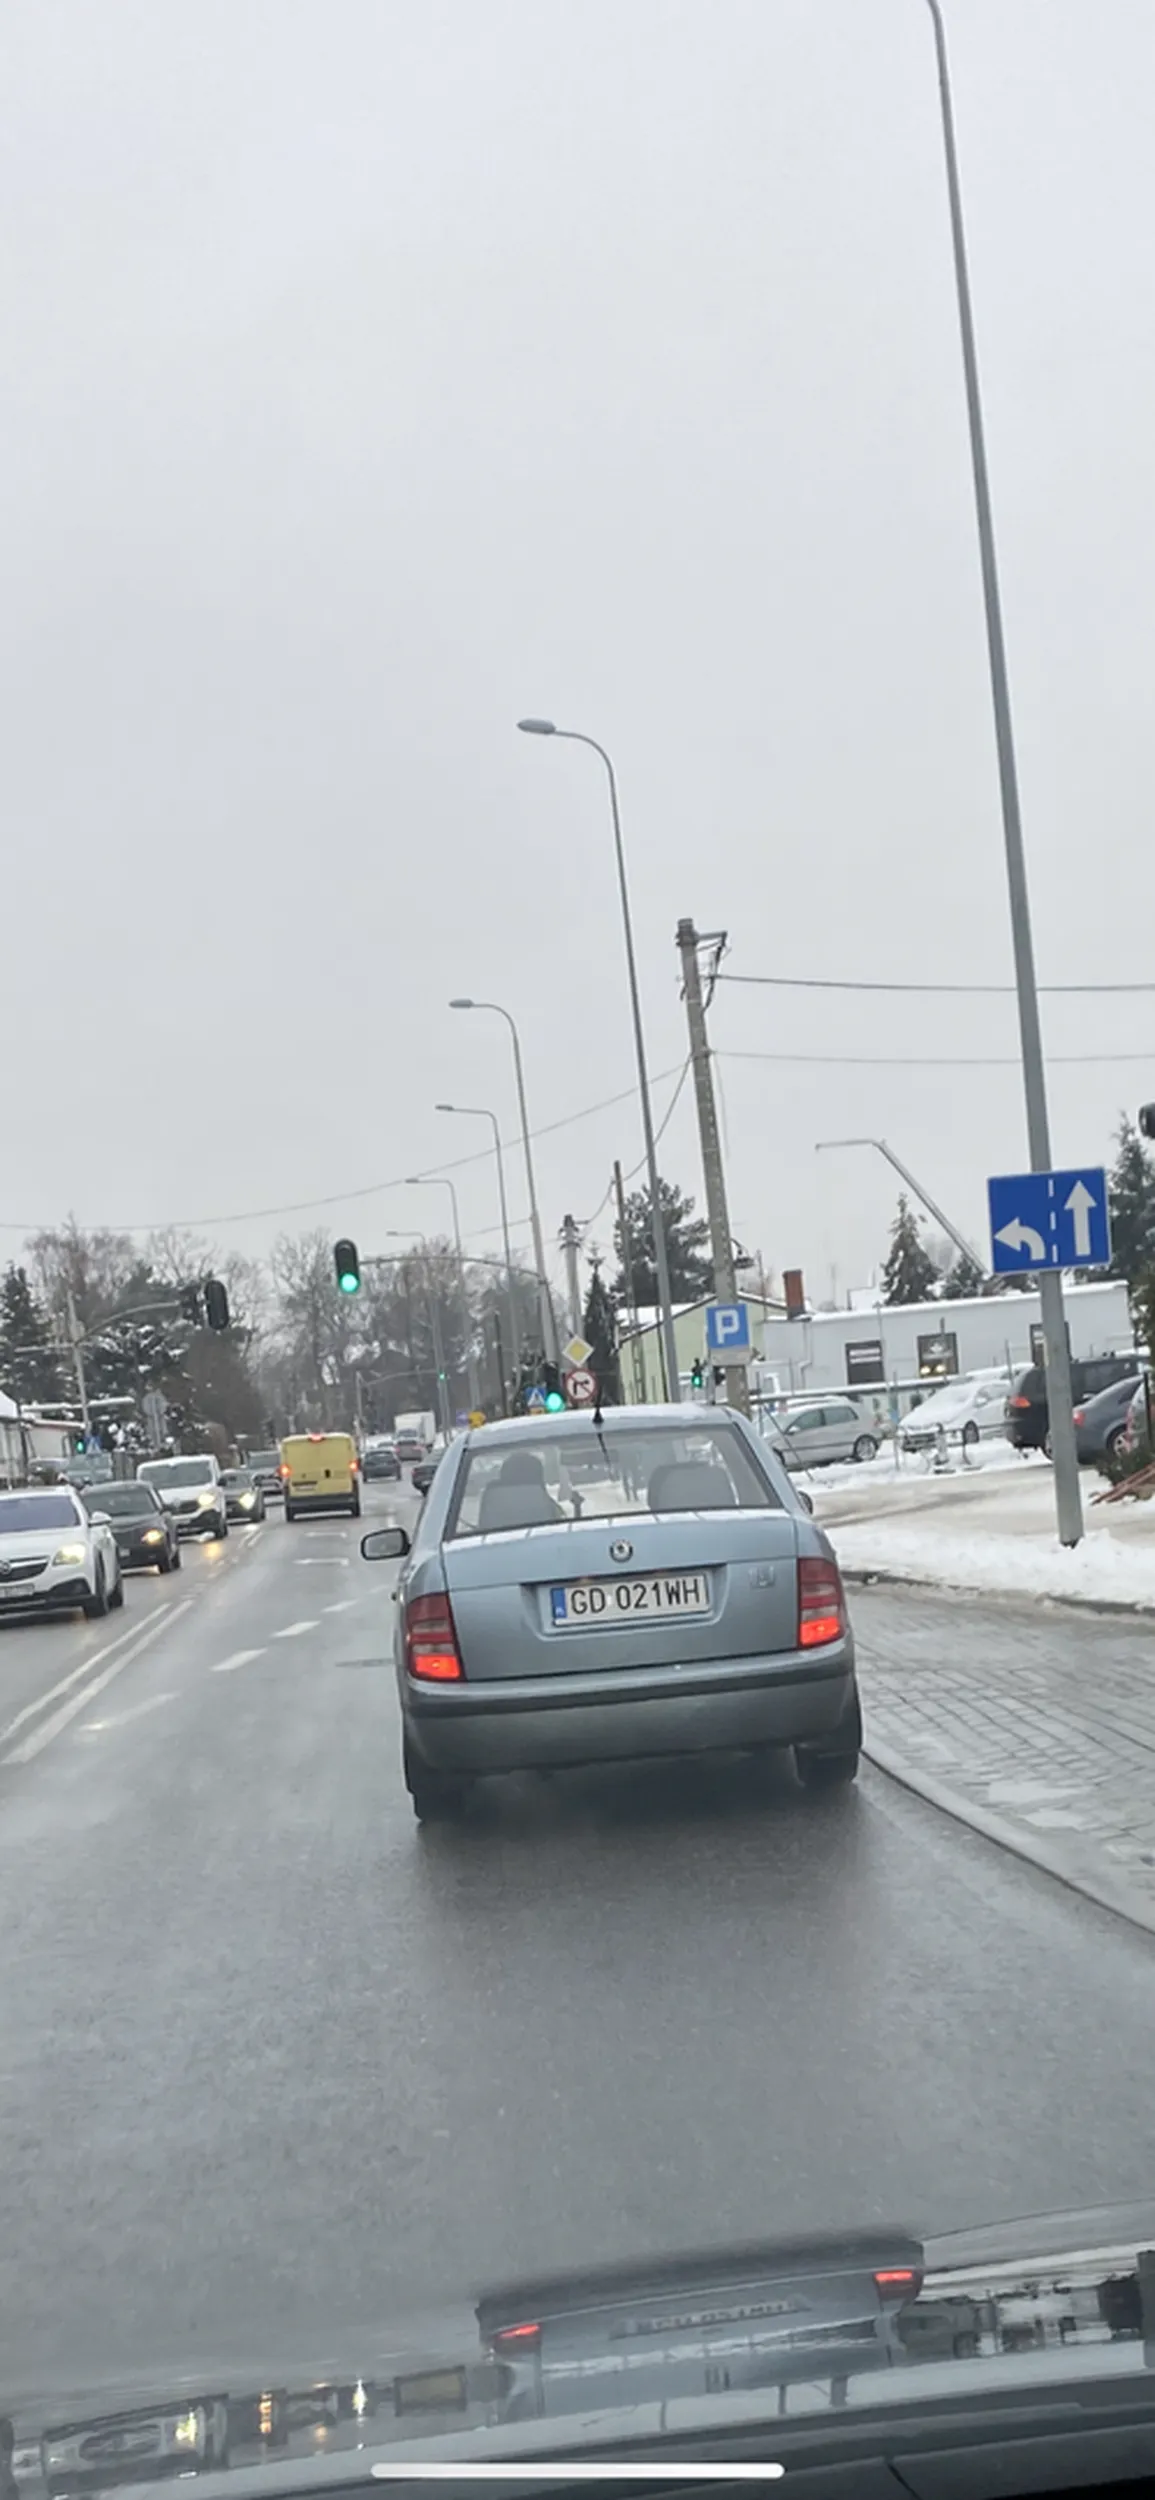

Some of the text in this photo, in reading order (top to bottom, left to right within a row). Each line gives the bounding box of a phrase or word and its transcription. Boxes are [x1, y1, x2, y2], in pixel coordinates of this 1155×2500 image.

[715, 1308, 740, 1344] P
[571, 1578, 700, 1614] GD 021WH
